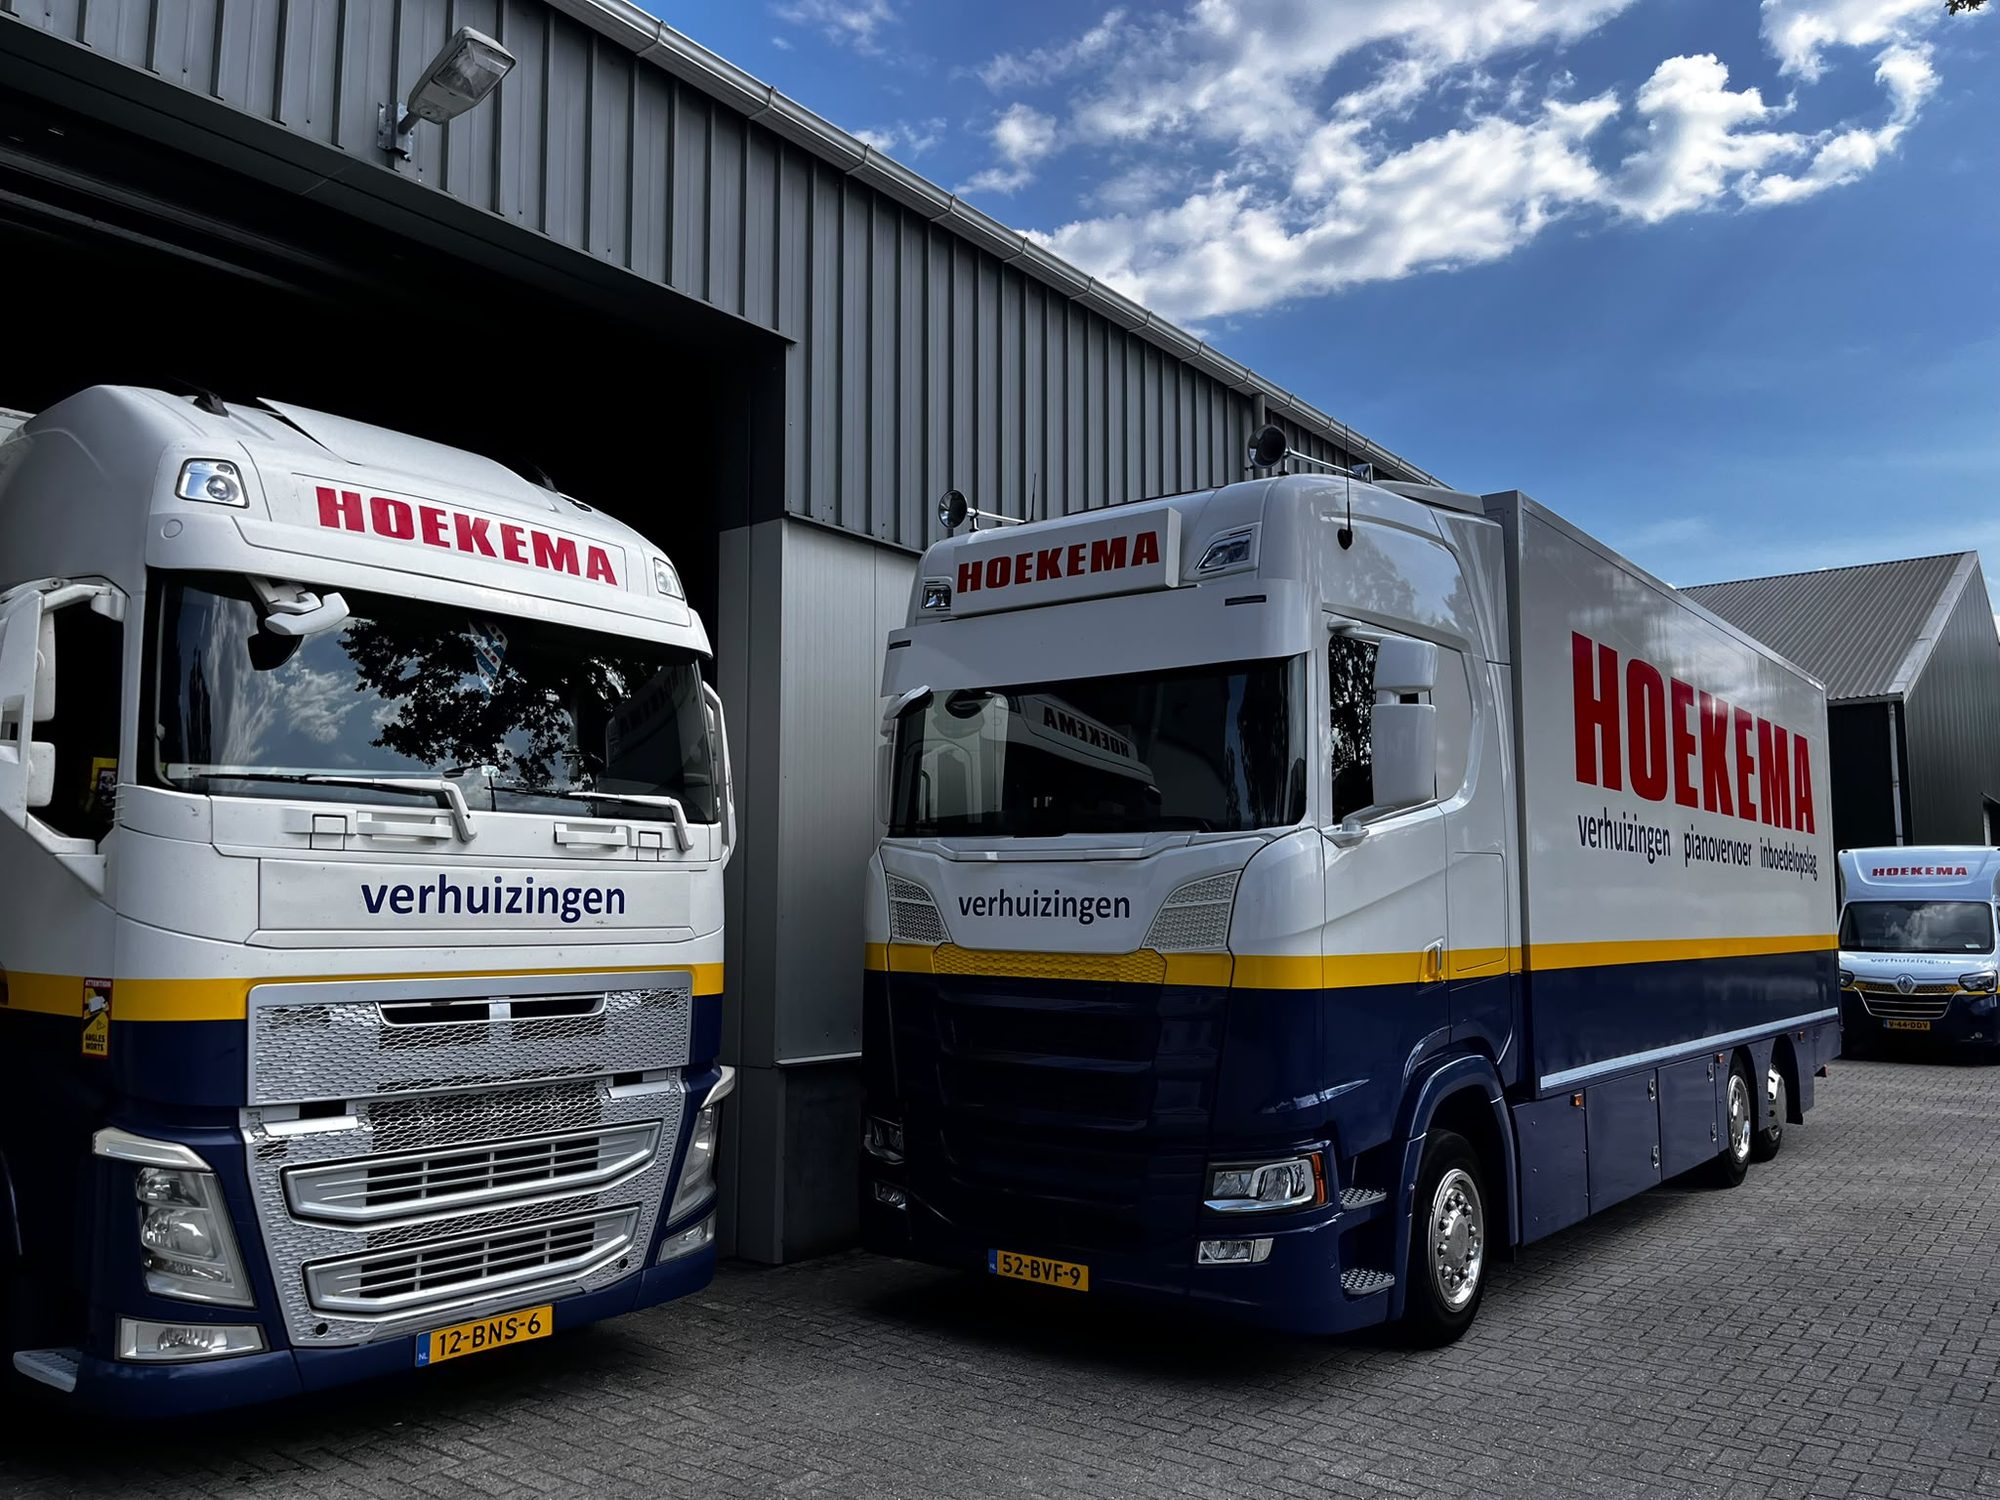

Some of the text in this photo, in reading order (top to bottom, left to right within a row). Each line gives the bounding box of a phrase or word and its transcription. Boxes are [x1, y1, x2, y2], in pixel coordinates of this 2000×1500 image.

[315, 486, 618, 586] HOEKEMA
[956, 531, 1160, 593] HOEKEMA
[1572, 631, 1815, 834] HOEKEMA
[1577, 806, 1818, 882] verhuizingen pianovervoer inboedelopslag
[1871, 866, 1968, 877] HOEKEMA
[361, 873, 625, 923] verhuizingen
[958, 888, 1130, 925] verhuizingen
[1002, 1254, 1081, 1286] 52-BVF-9
[418, 1352, 429, 1361] NL
[439, 1312, 541, 1356] 12-BNS-6
